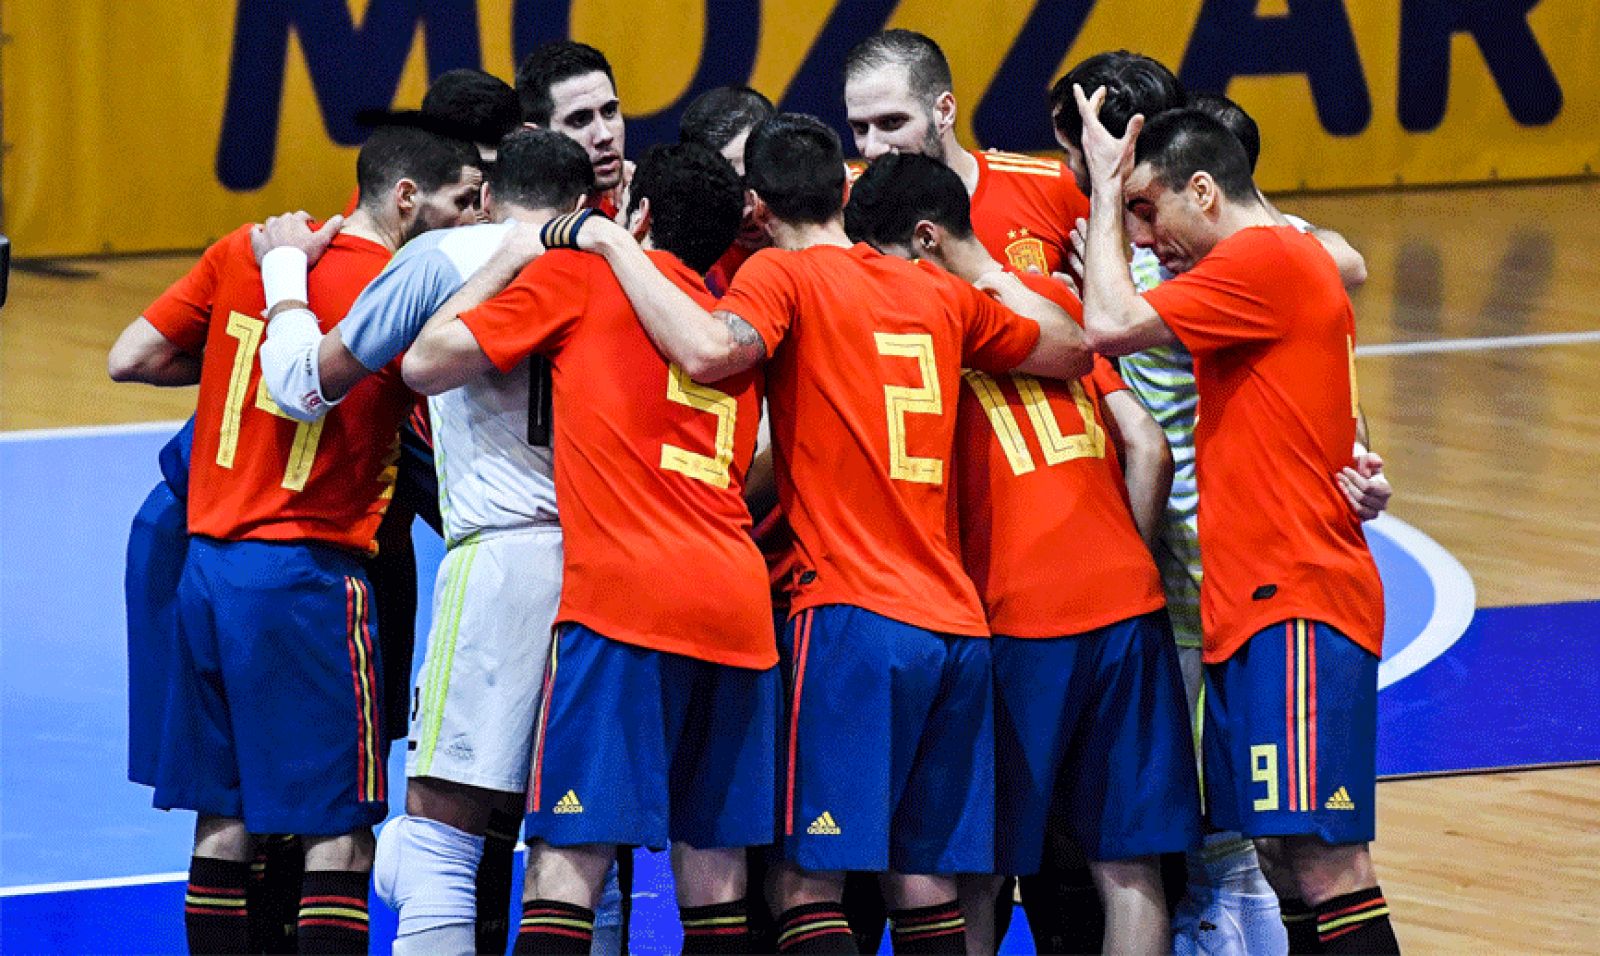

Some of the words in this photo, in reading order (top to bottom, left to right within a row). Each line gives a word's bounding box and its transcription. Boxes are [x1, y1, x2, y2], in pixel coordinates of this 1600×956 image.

[873, 332, 943, 484] 2
[961, 367, 1106, 476] 10
[1250, 743, 1279, 812] 9
